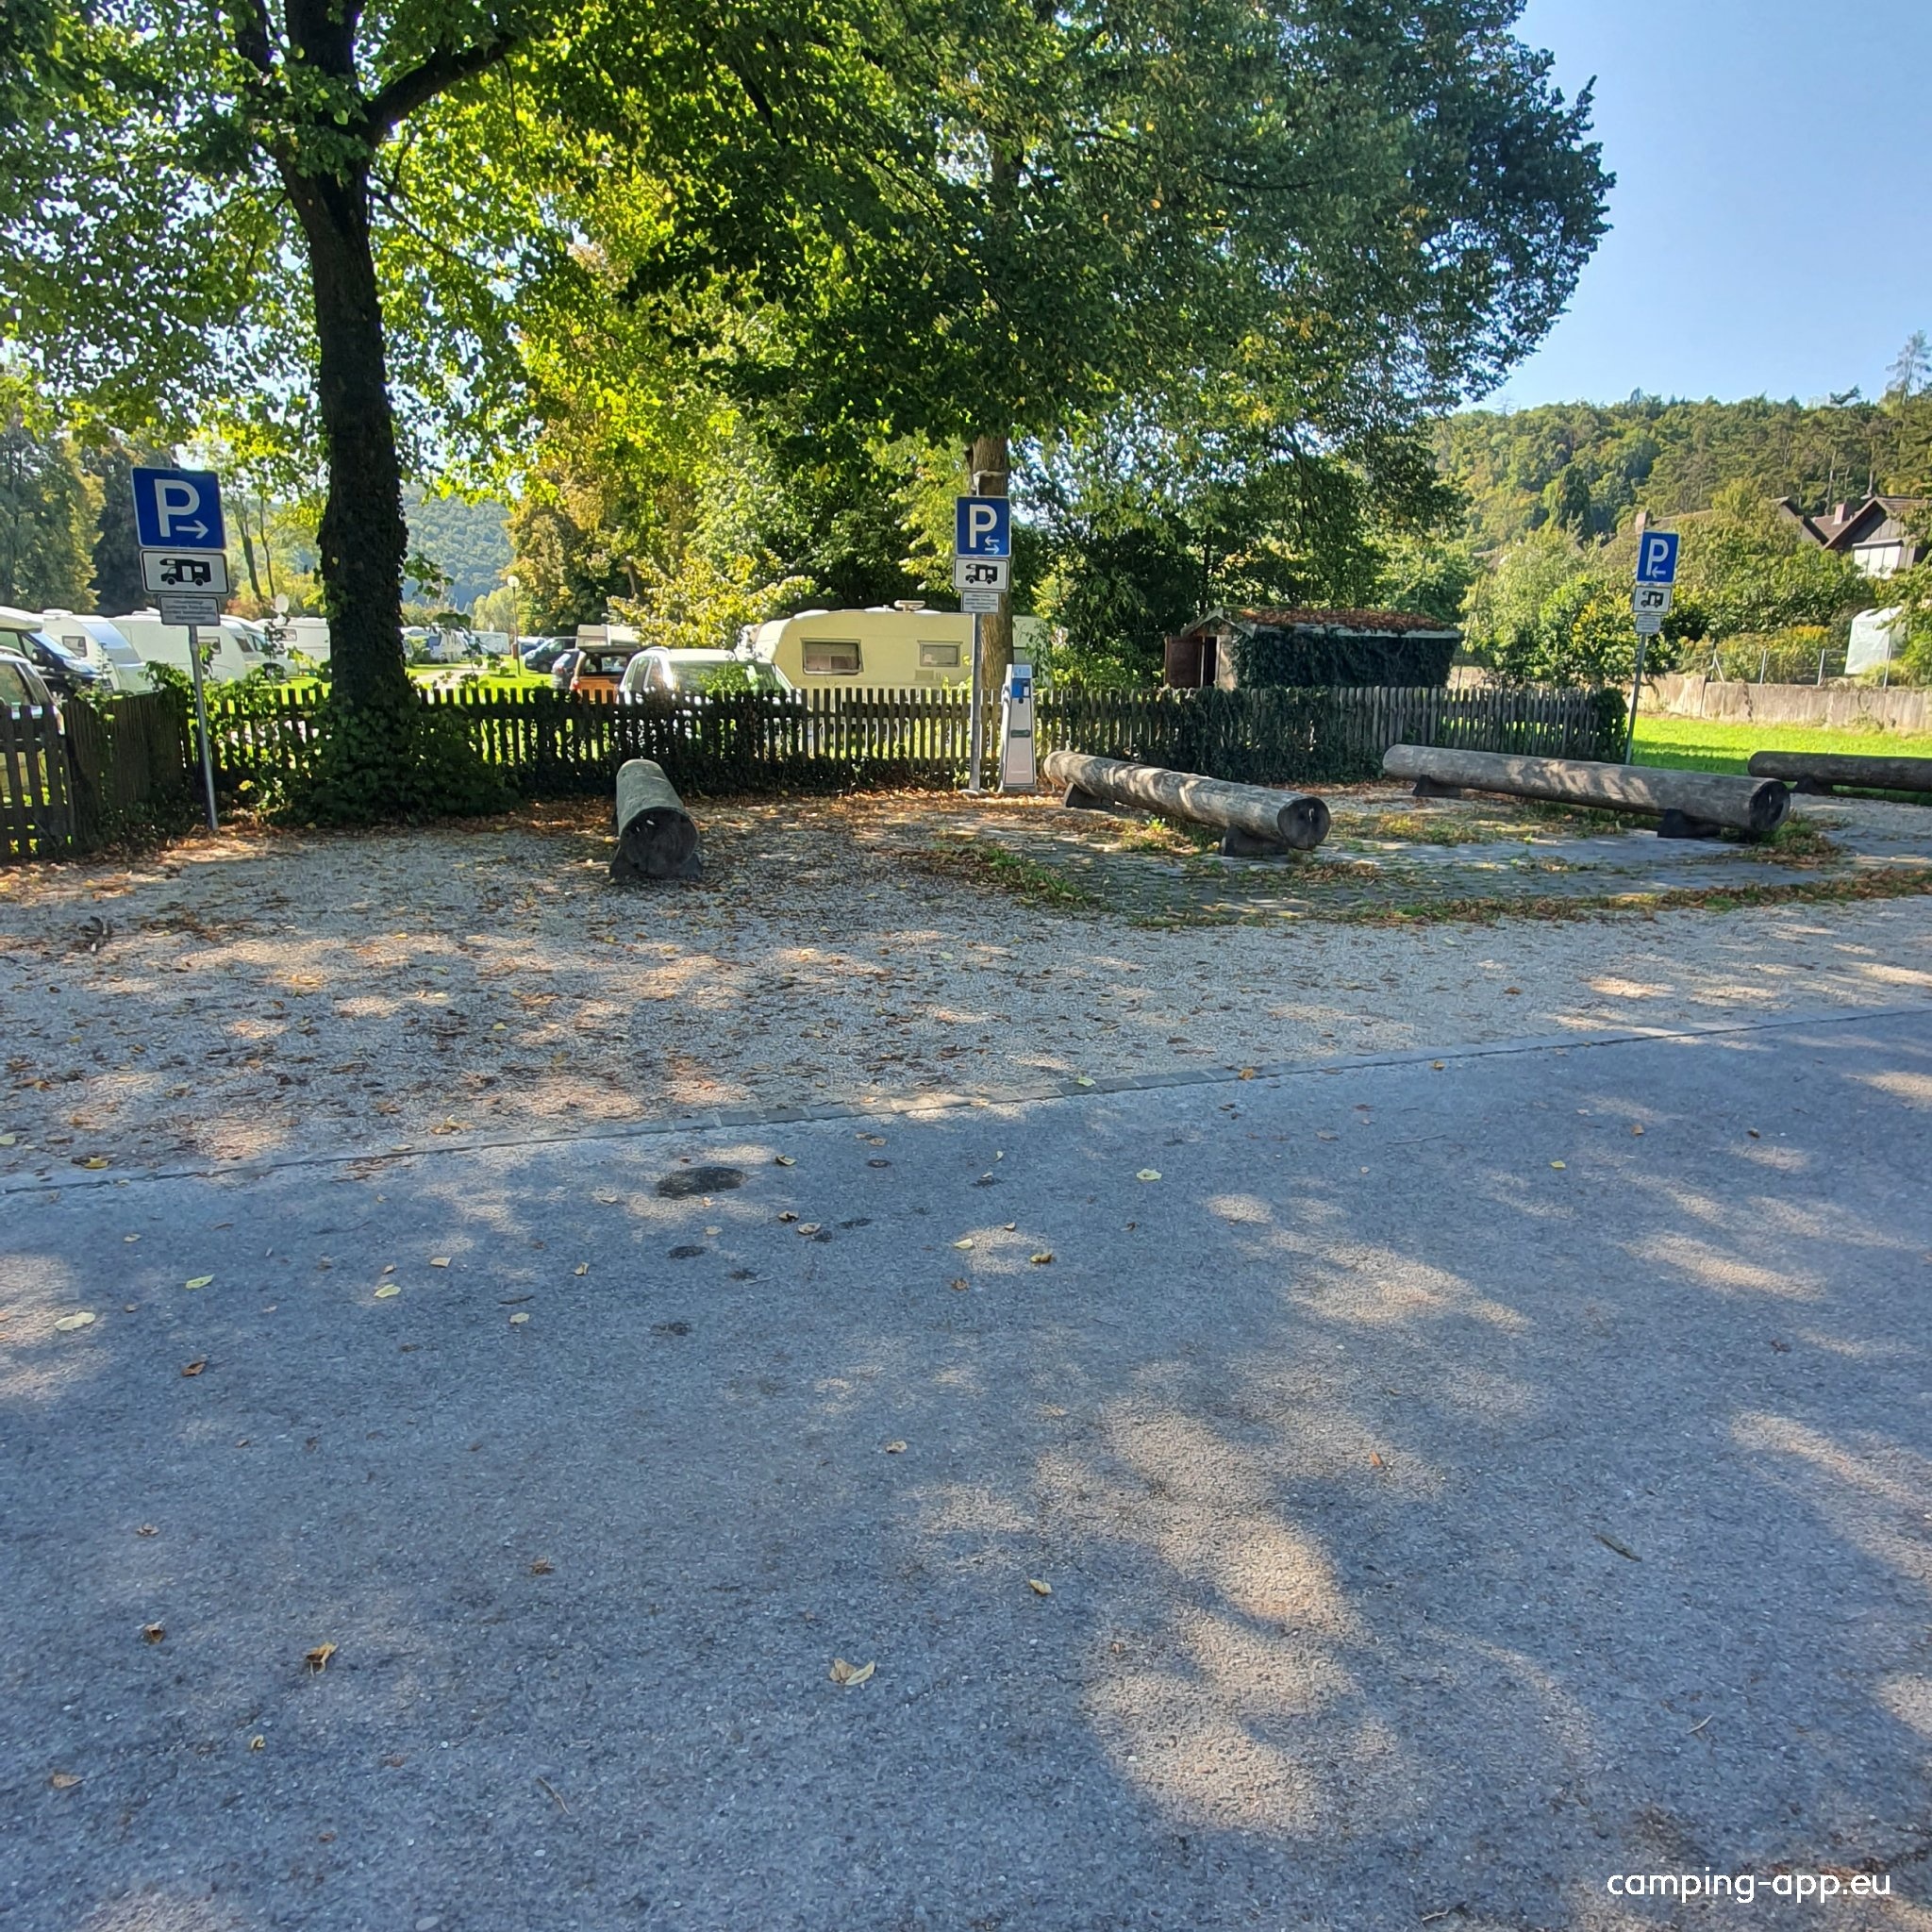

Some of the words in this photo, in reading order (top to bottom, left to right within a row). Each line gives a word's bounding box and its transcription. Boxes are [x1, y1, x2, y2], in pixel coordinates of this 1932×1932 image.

[154, 478, 200, 538] P
[970, 504, 997, 548] P
[1646, 539, 1669, 576] P
